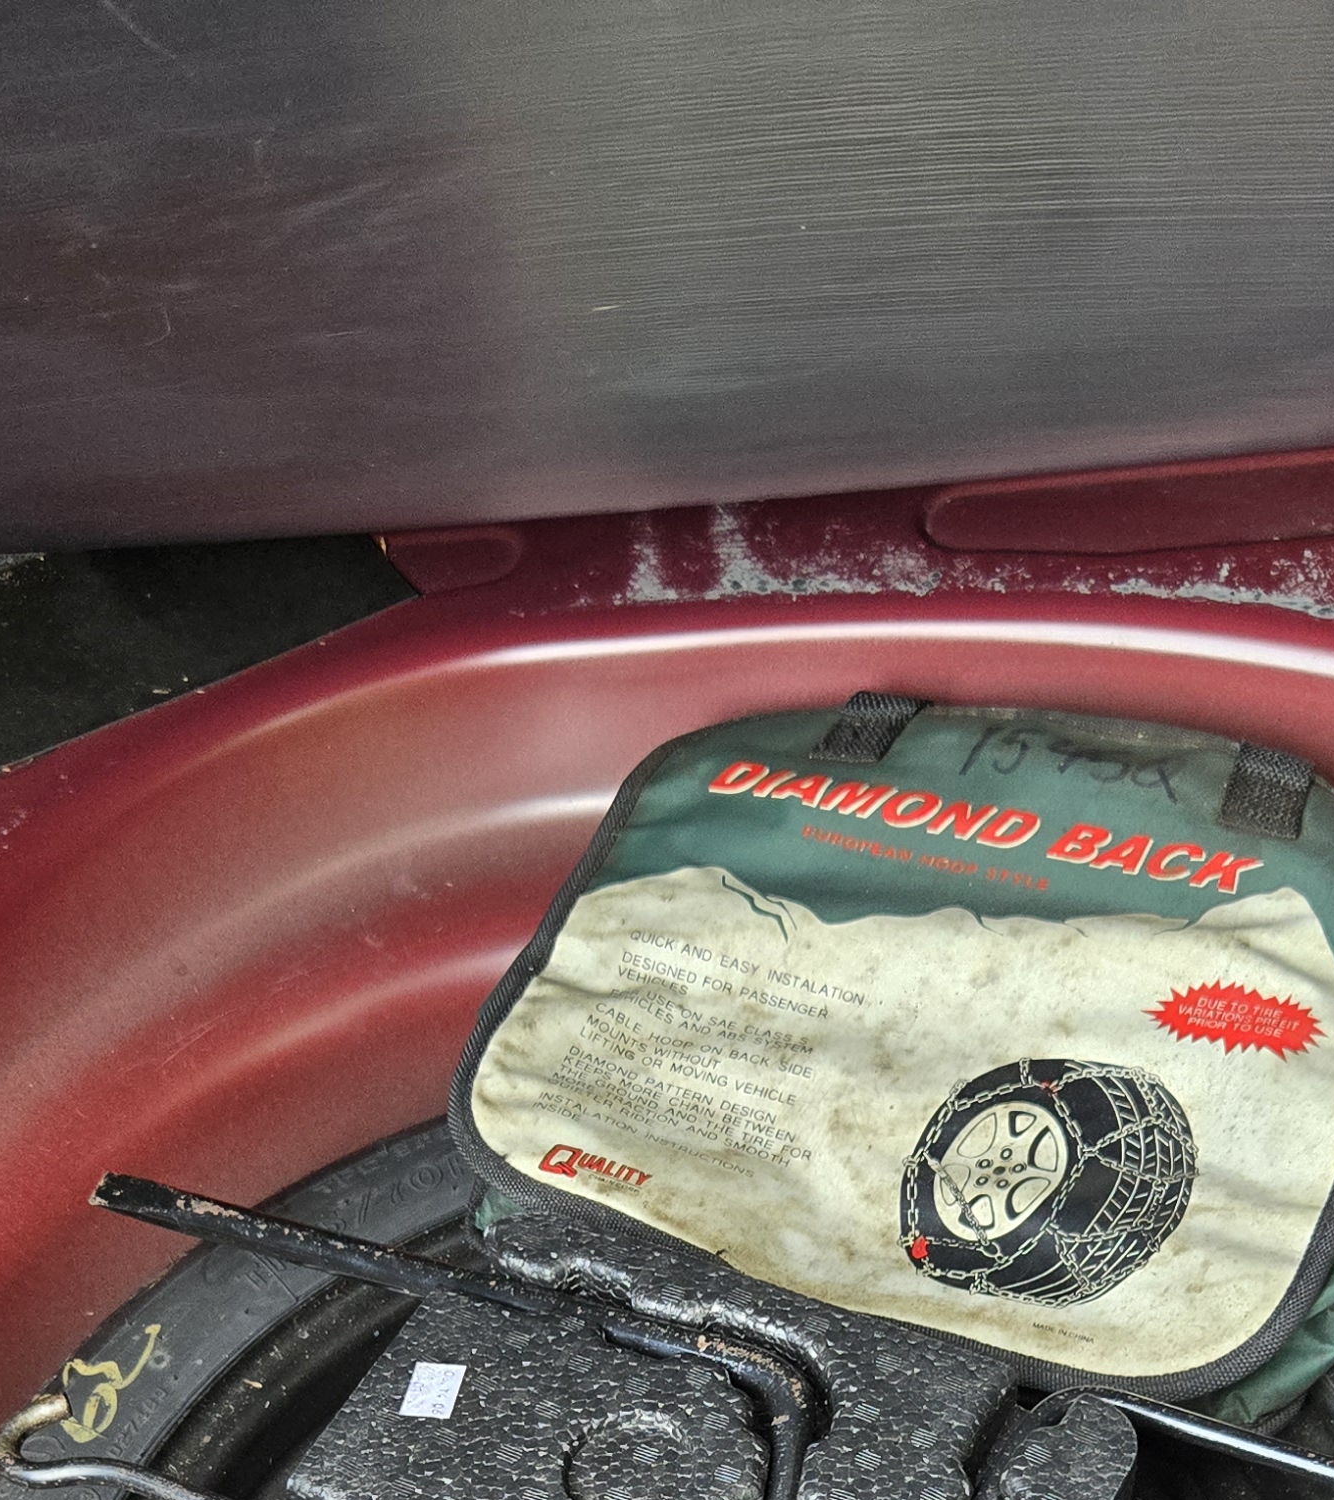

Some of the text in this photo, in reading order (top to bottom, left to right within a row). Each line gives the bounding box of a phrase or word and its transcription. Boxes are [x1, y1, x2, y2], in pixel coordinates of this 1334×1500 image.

[708, 760, 1264, 894] DIAMOND BACK
[801, 823, 1051, 892] EUROPEAN HOOP STYLE
[617, 965, 689, 996] VEHICLES
[621, 950, 829, 1020] DESIGNED FOR PASSENGER
[629, 929, 865, 1006] QUICK AND EASY INSTALATION
[646, 990, 676, 1012] USE
[680, 1007, 703, 1022] ON
[708, 1015, 738, 1031] SAE
[743, 1024, 794, 1043] CLASS
[799, 1036, 810, 1046] S
[678, 1020, 711, 1036] AND
[717, 1030, 747, 1043] ABS
[752, 1036, 814, 1056] SYSTEM
[1178, 1004, 1253, 1025] VARIATIONS
[1186, 1016, 1284, 1039] PRIOR TO USE
[1196, 995, 1284, 1020] DUE TO TIRE
[579, 1026, 798, 1107] LIFTING OR MOVING VEHICLE
[586, 1014, 722, 1071] MOUNTS WITHOUT
[595, 1002, 814, 1079] CABLE HOOP ON BACK SIDE
[531, 1100, 582, 1124] INSIDE
[559, 1063, 813, 1161] THE GROUND AND THE TIRE FOR
[562, 1055, 797, 1144] KEEPS MORE CHAIN BETWEEN
[568, 1045, 778, 1126] DIAMOND PATTERN DESIGN
[619, 1106, 654, 1128] RIDE
[537, 1090, 755, 1180] INSTALATION INSTRUCTIONS
[604, 1090, 680, 1128] TRACTION
[686, 1124, 719, 1142] AND
[722, 1136, 792, 1169] SMOOTH
[538, 1143, 654, 1187] QUALITY
[1032, 1321, 1095, 1345] MADE IN CHINA
